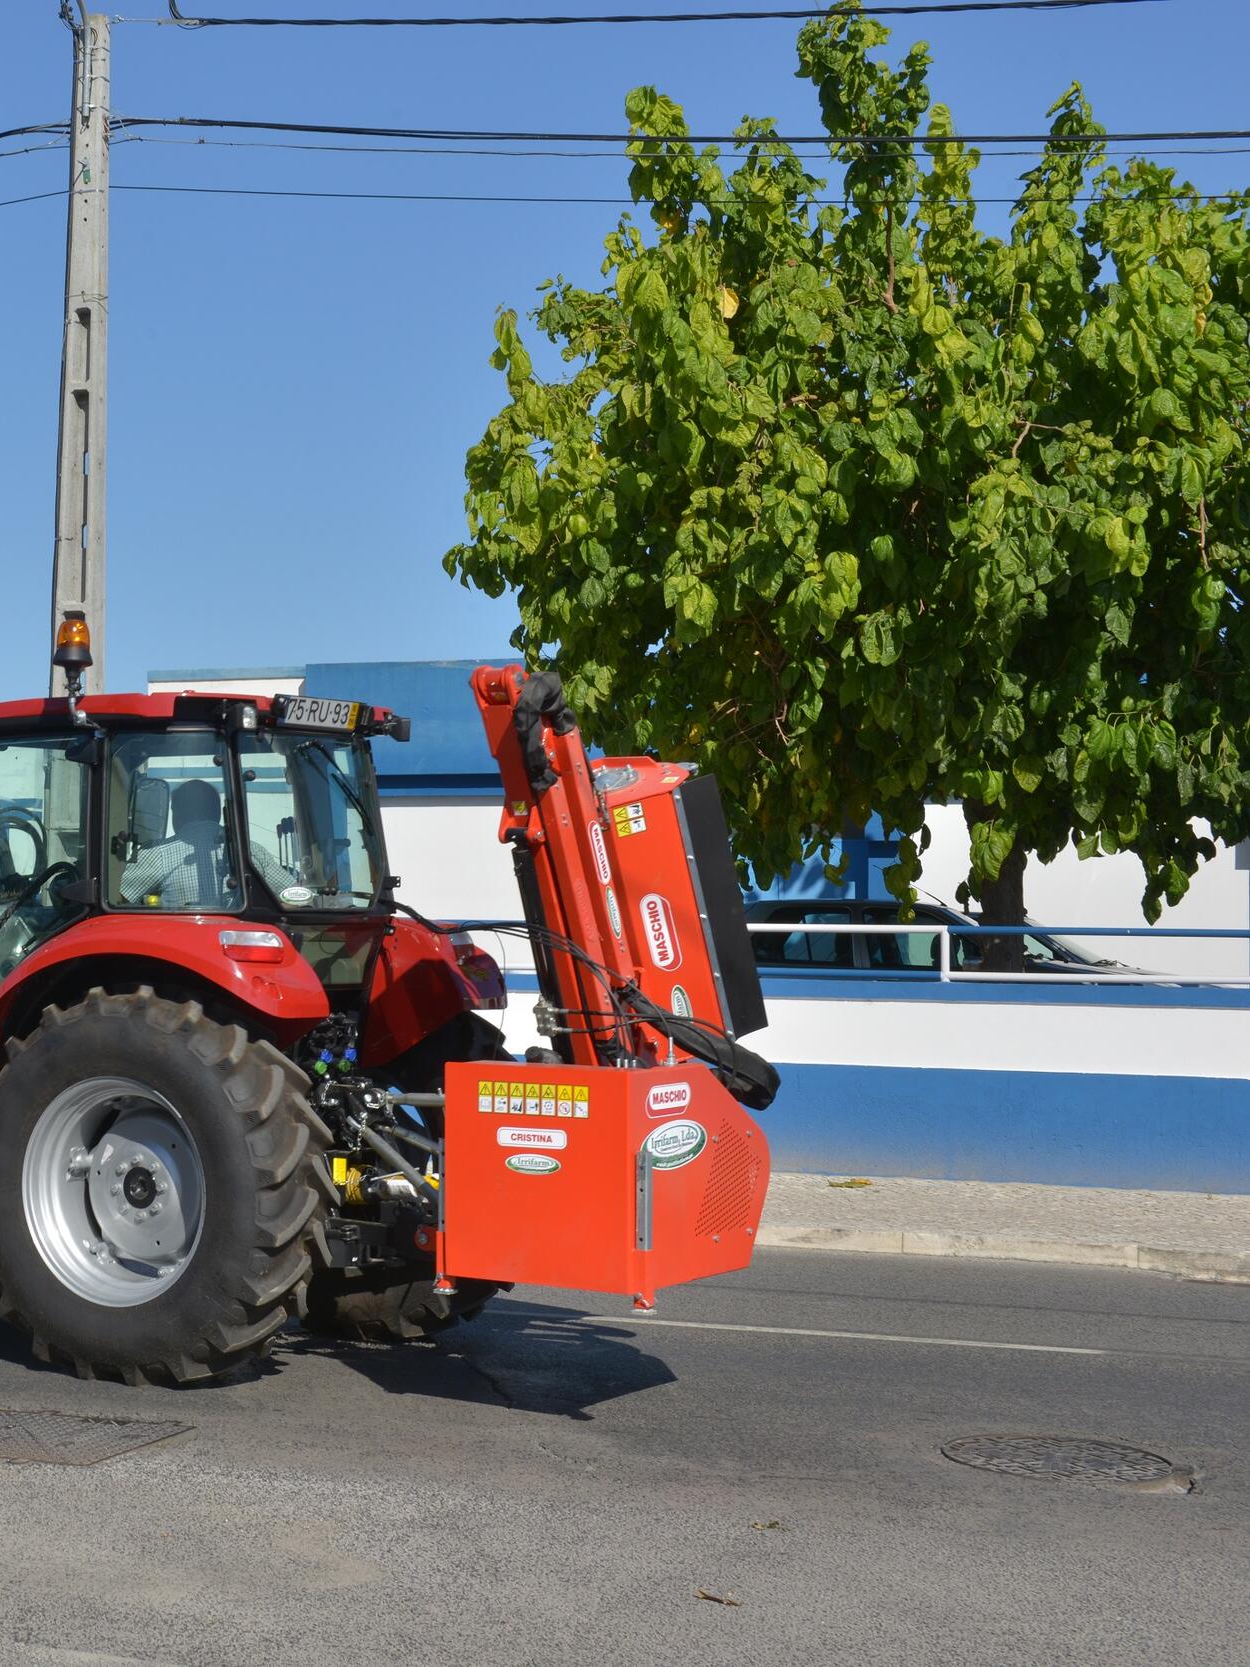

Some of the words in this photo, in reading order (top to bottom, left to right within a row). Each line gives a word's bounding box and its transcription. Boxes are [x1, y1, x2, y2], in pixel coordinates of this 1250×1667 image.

[594, 828, 609, 879] MASCHIO
[646, 900, 670, 962] MASCHIO
[652, 1089, 687, 1105] MASCHIO
[510, 1133, 553, 1143] CRISTINA
[517, 1157, 550, 1167] Irrifarm
